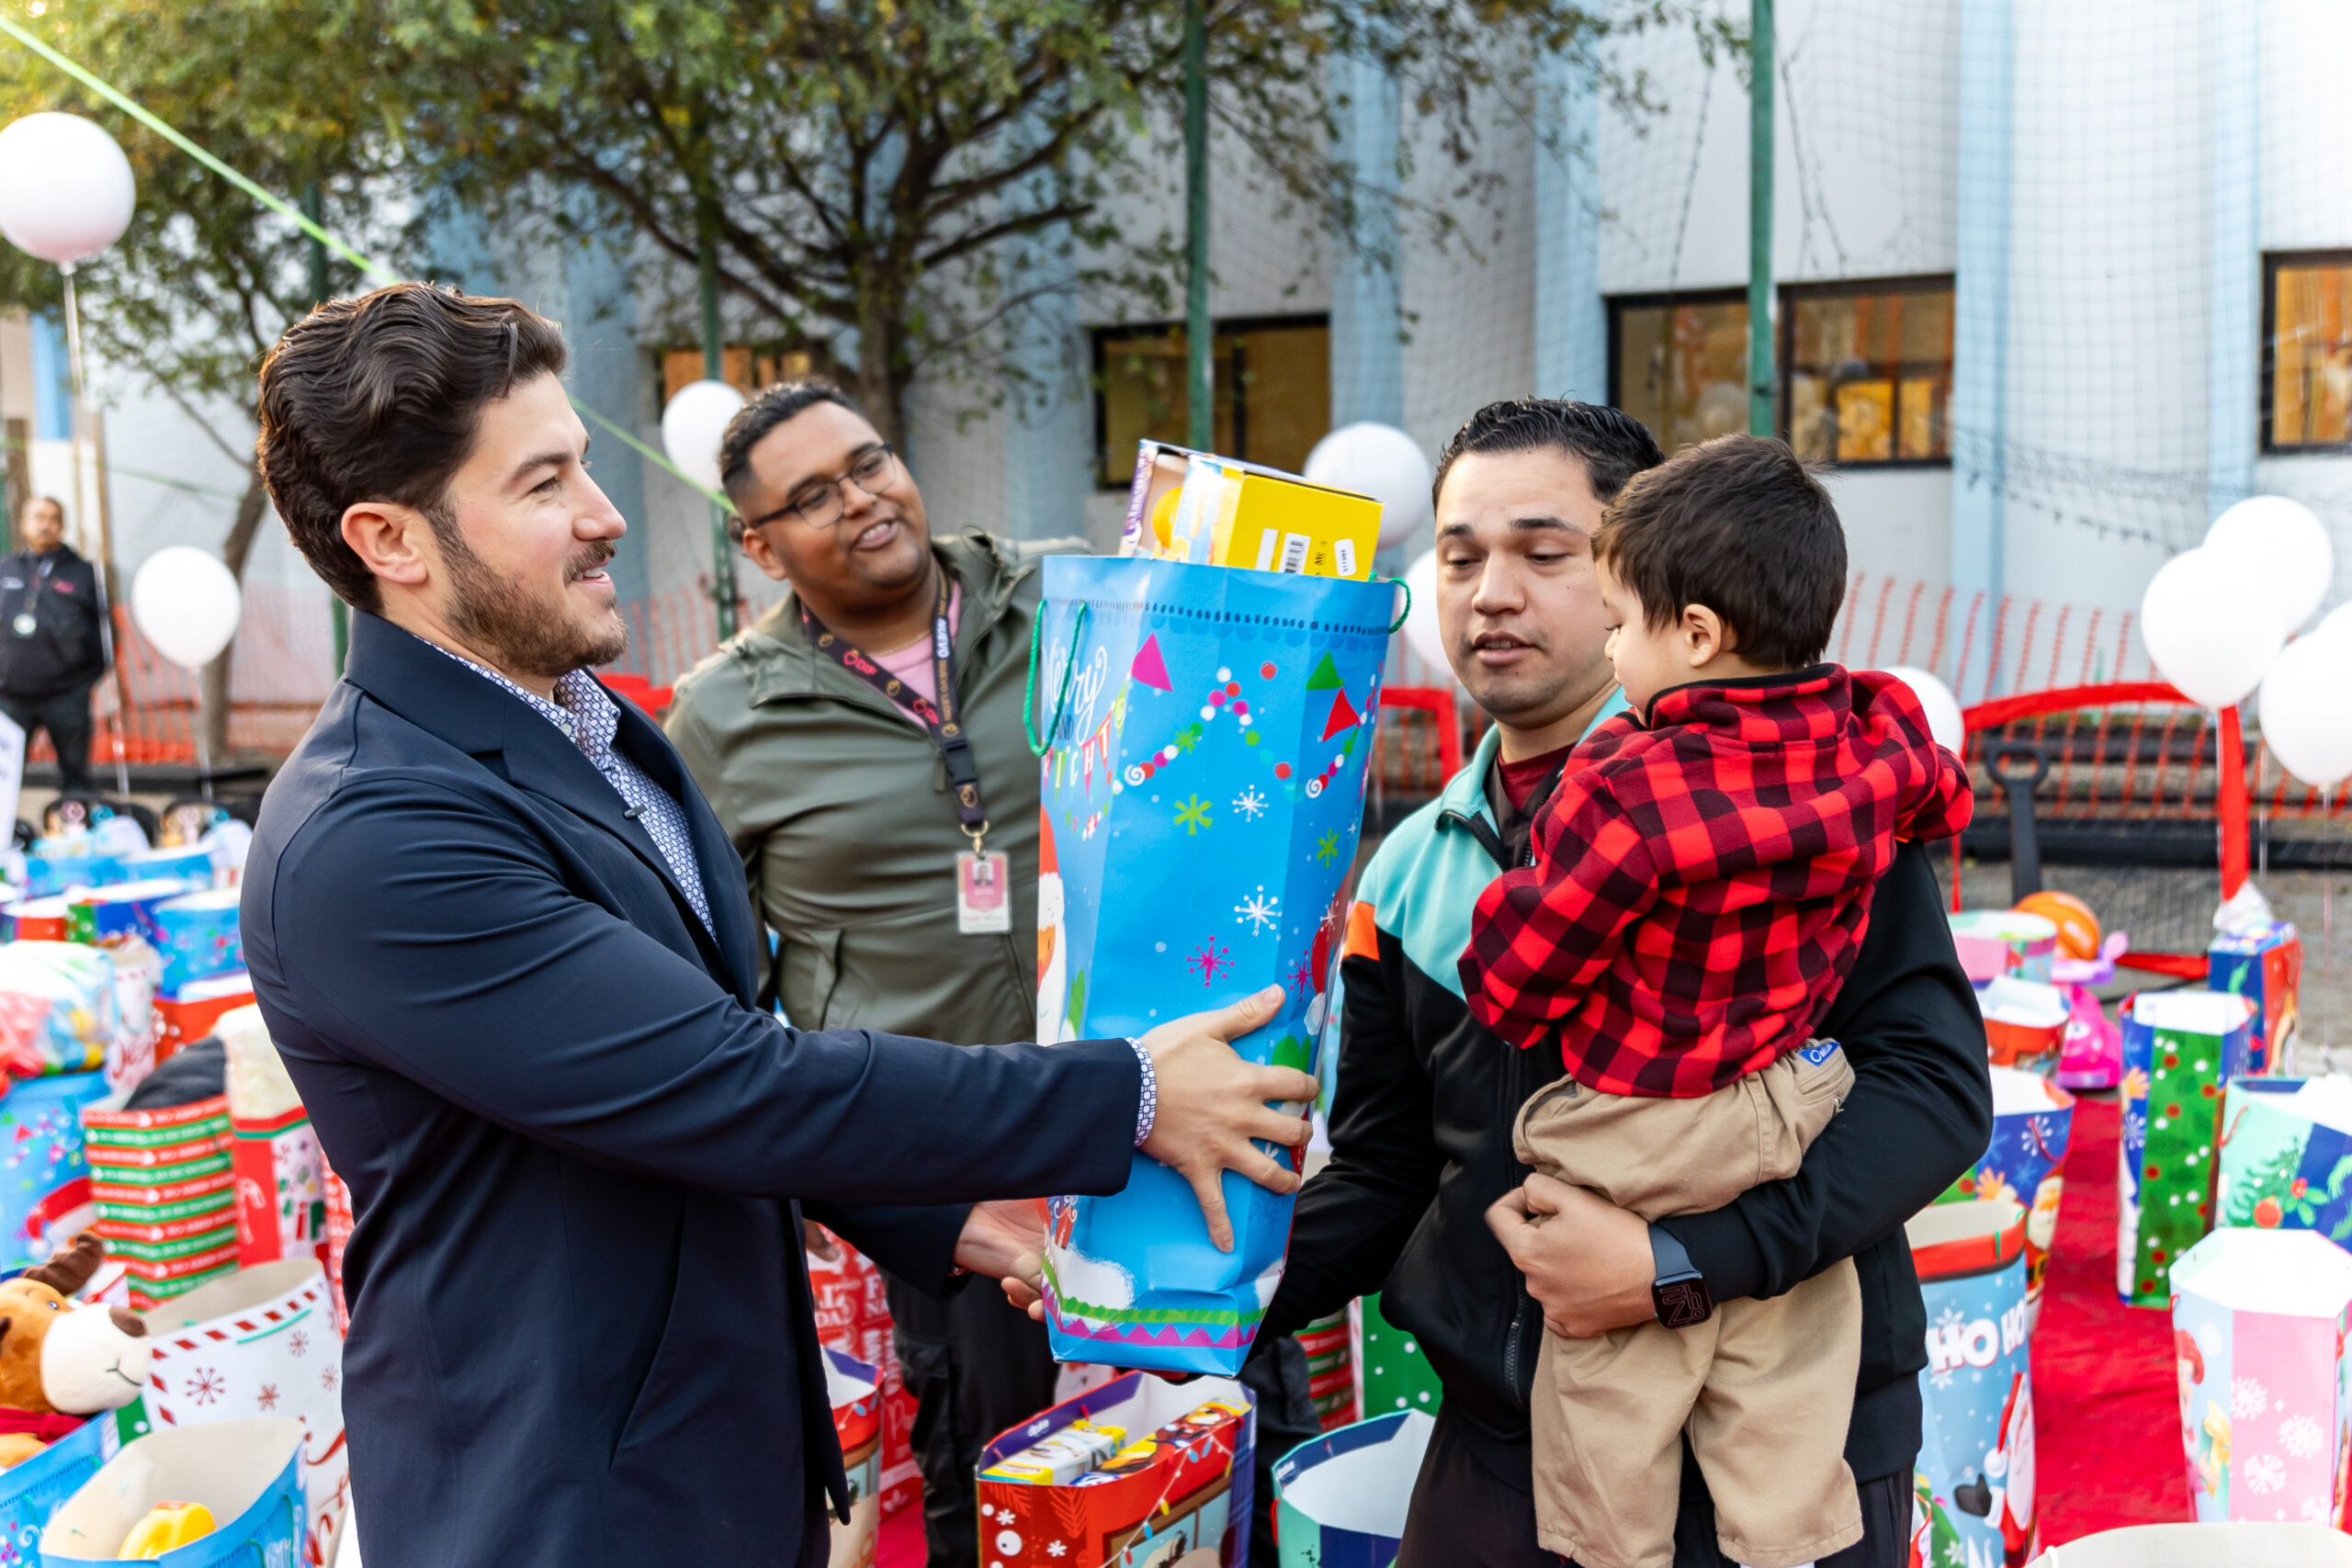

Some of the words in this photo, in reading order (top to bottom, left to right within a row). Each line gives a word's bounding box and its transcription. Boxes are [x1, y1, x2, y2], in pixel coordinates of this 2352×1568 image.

[935, 617, 950, 659] NUEVO
[854, 659, 877, 676] DIF
[938, 660, 948, 693] NUEVO
[1043, 717, 1112, 790] RIGHT
[1925, 1318, 2001, 1374] HO
[2001, 1298, 2027, 1358] HO
